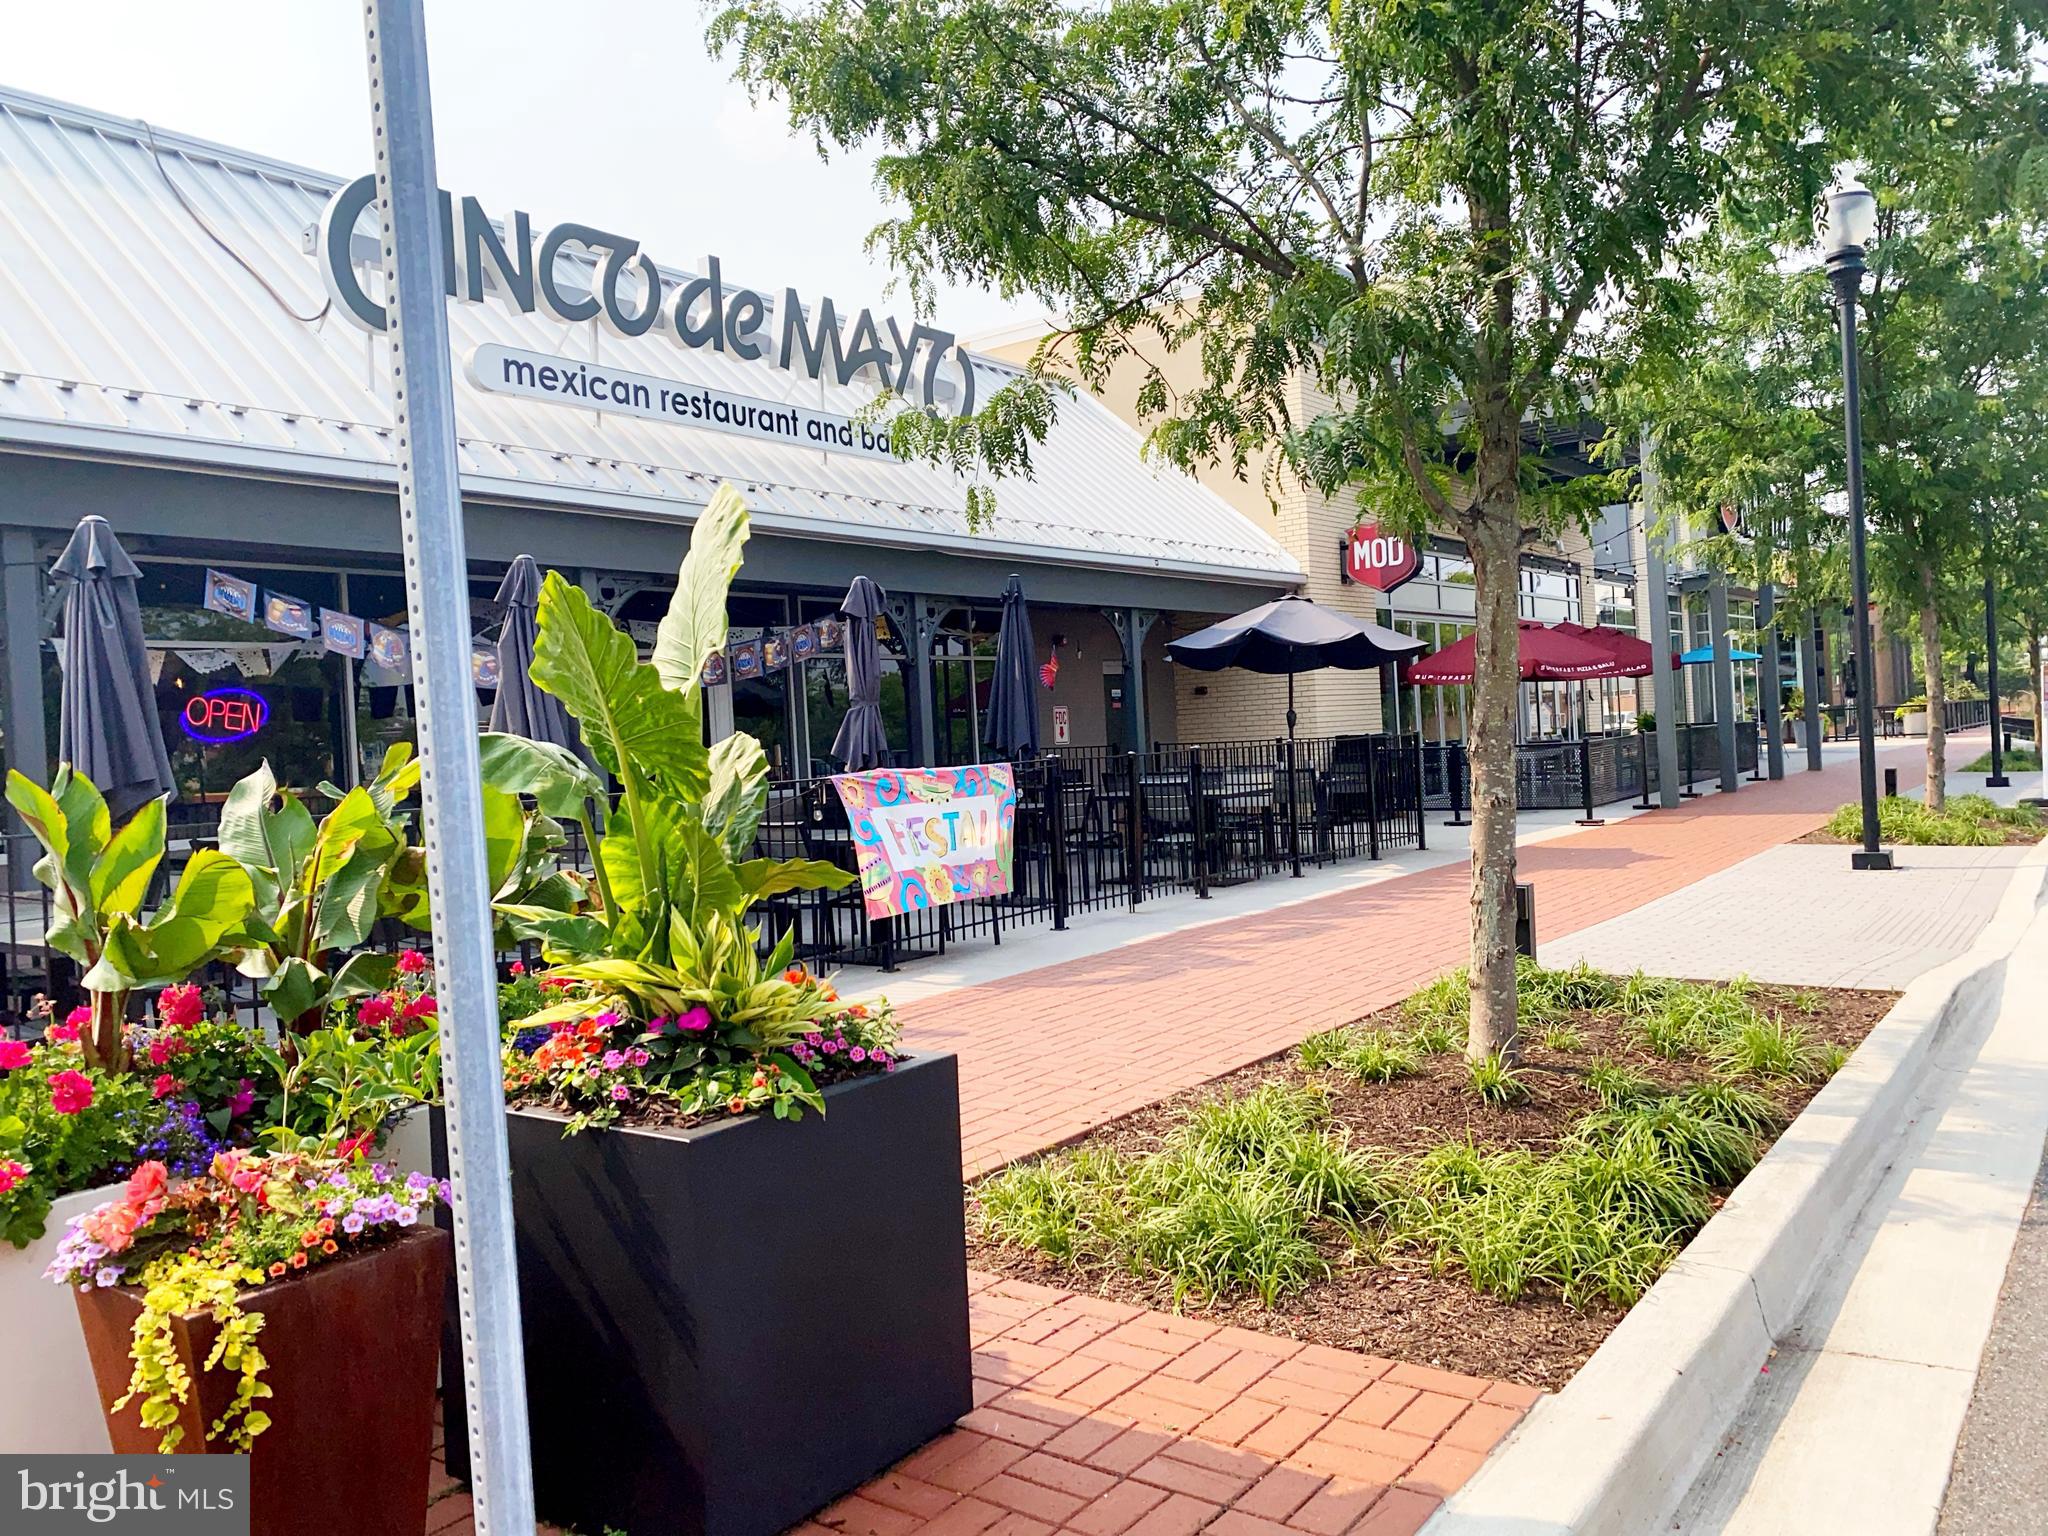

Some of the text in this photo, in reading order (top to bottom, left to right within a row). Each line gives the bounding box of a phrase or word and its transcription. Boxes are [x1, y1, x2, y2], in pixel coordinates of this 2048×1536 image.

[673, 254, 765, 361] de
[779, 287, 975, 422] MAYO
[503, 358, 893, 454] mexican restaurant and ba
[1353, 536, 1404, 571] MOD
[186, 696, 260, 733] OPEN
[1055, 711, 1067, 725] FDC
